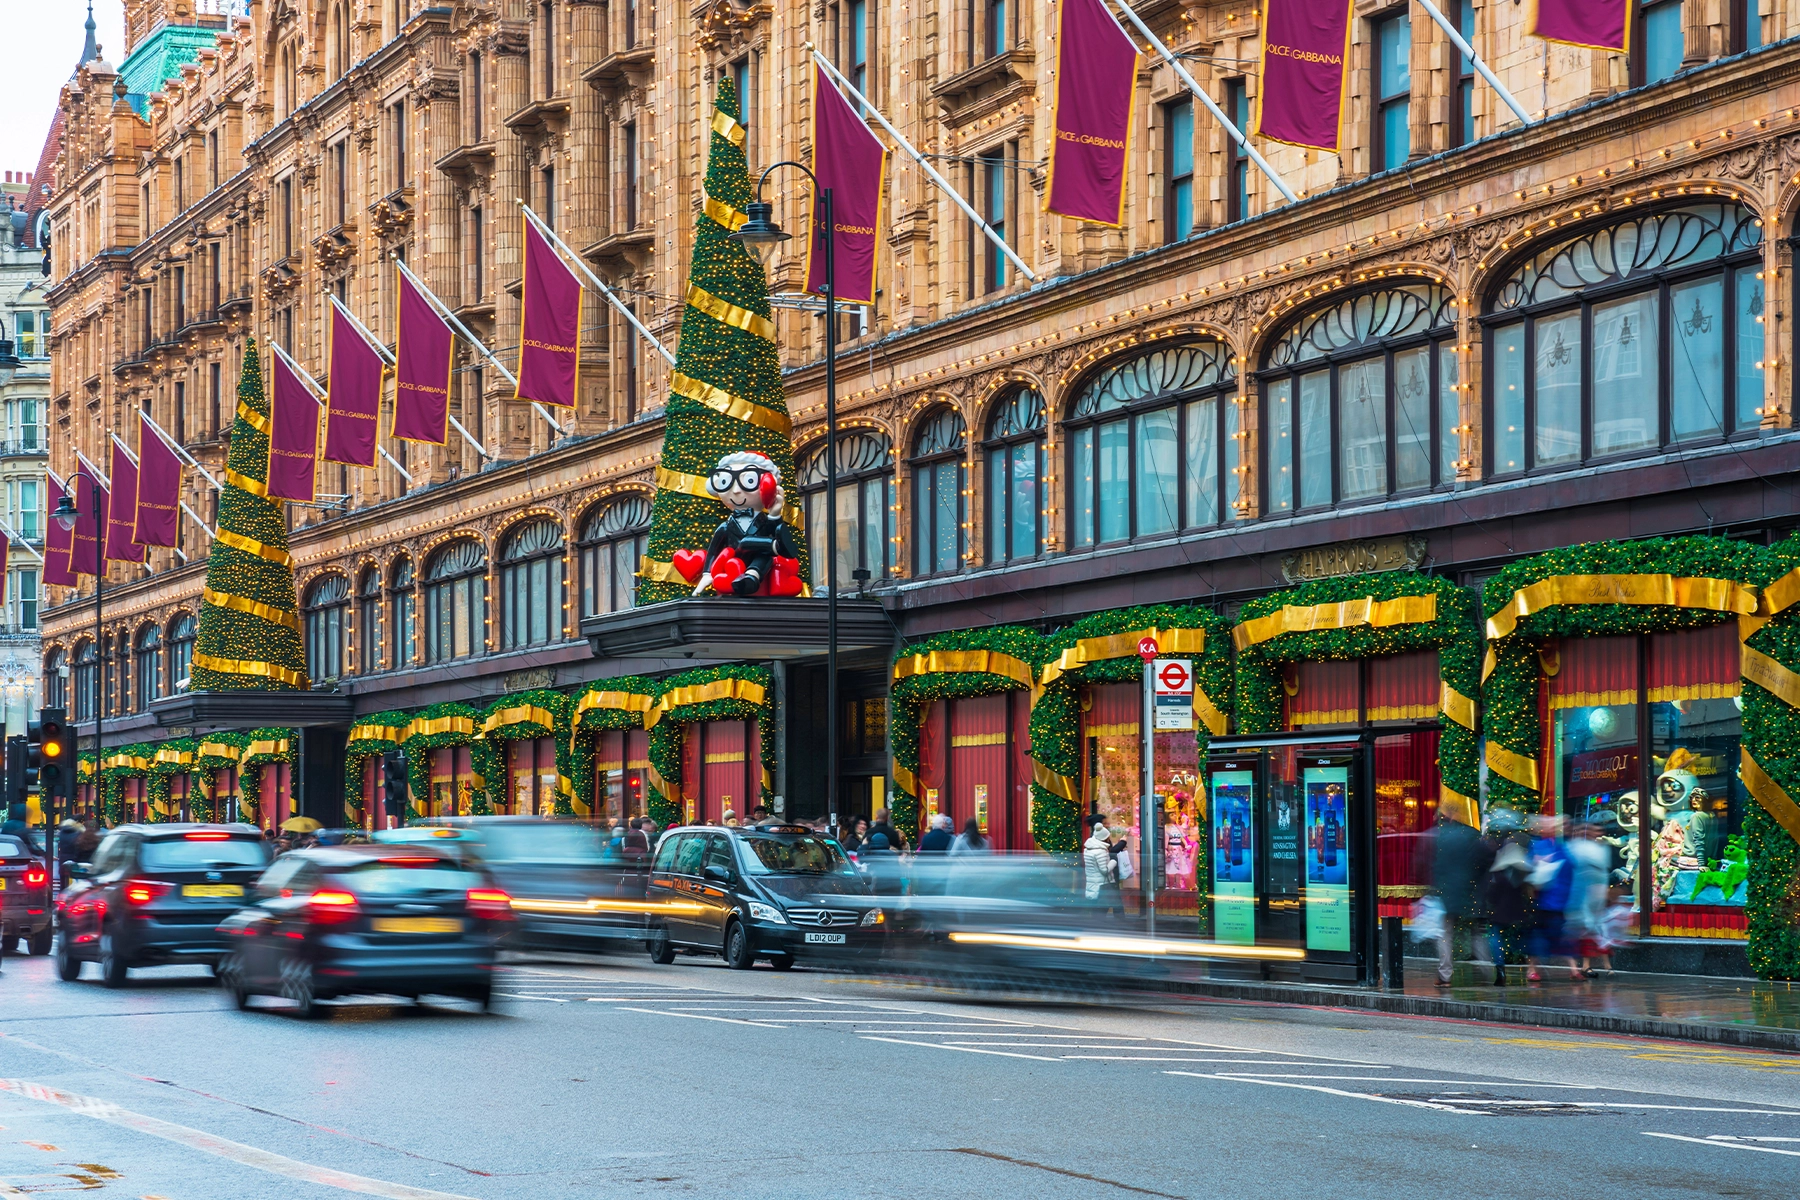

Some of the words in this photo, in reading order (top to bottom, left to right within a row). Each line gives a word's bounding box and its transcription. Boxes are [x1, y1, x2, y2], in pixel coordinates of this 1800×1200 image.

[1265, 42, 1290, 56] DOLCE
[1292, 49, 1341, 64] GABBANA
[1080, 134, 1124, 149] GABBANA
[834, 223, 875, 235] GABBANA
[523, 339, 541, 348] DOLCE
[544, 343, 576, 354] GABBANA
[397, 381, 415, 391] DOLCE
[417, 385, 447, 395] GABBANA
[347, 411, 377, 421] GABBANA
[1299, 540, 1378, 579] HARRODS
[1139, 643, 1157, 653] KA
[673, 877, 690, 891] TAXI
[809, 934, 826, 942] LD12
[827, 935, 842, 943] OUP
